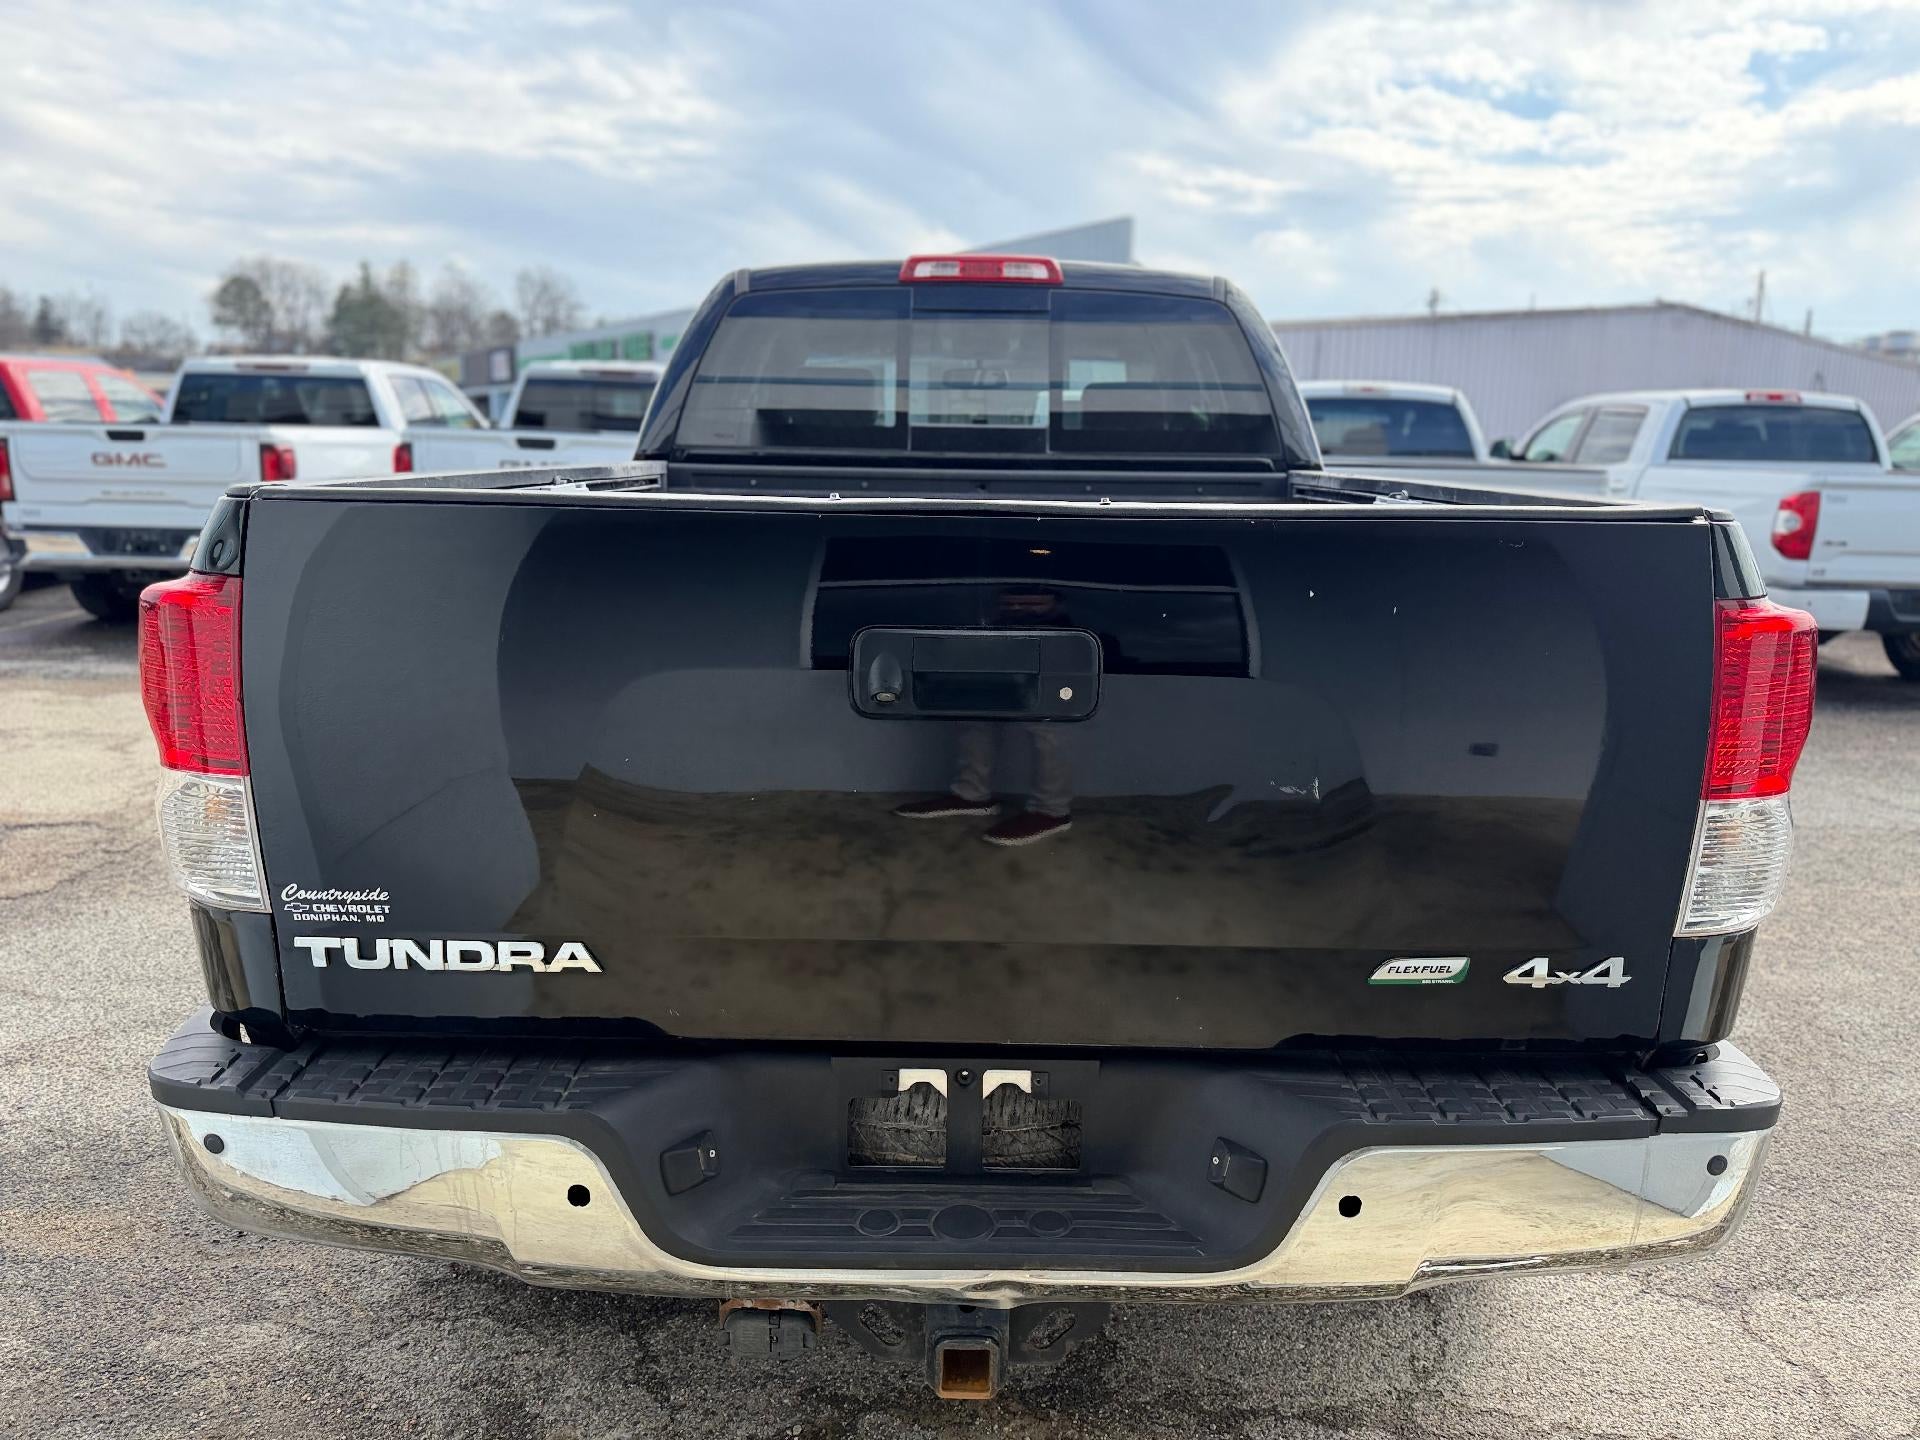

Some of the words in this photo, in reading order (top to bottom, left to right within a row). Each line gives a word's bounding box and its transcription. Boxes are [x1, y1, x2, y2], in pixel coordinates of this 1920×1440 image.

[90, 452, 166, 468] GMC
[281, 883, 390, 904] Countryside
[312, 903, 391, 914] CHEVROLET
[365, 914, 385, 923] MO
[293, 936, 603, 973] TUNDRA
[1502, 956, 1633, 988] 4x4
